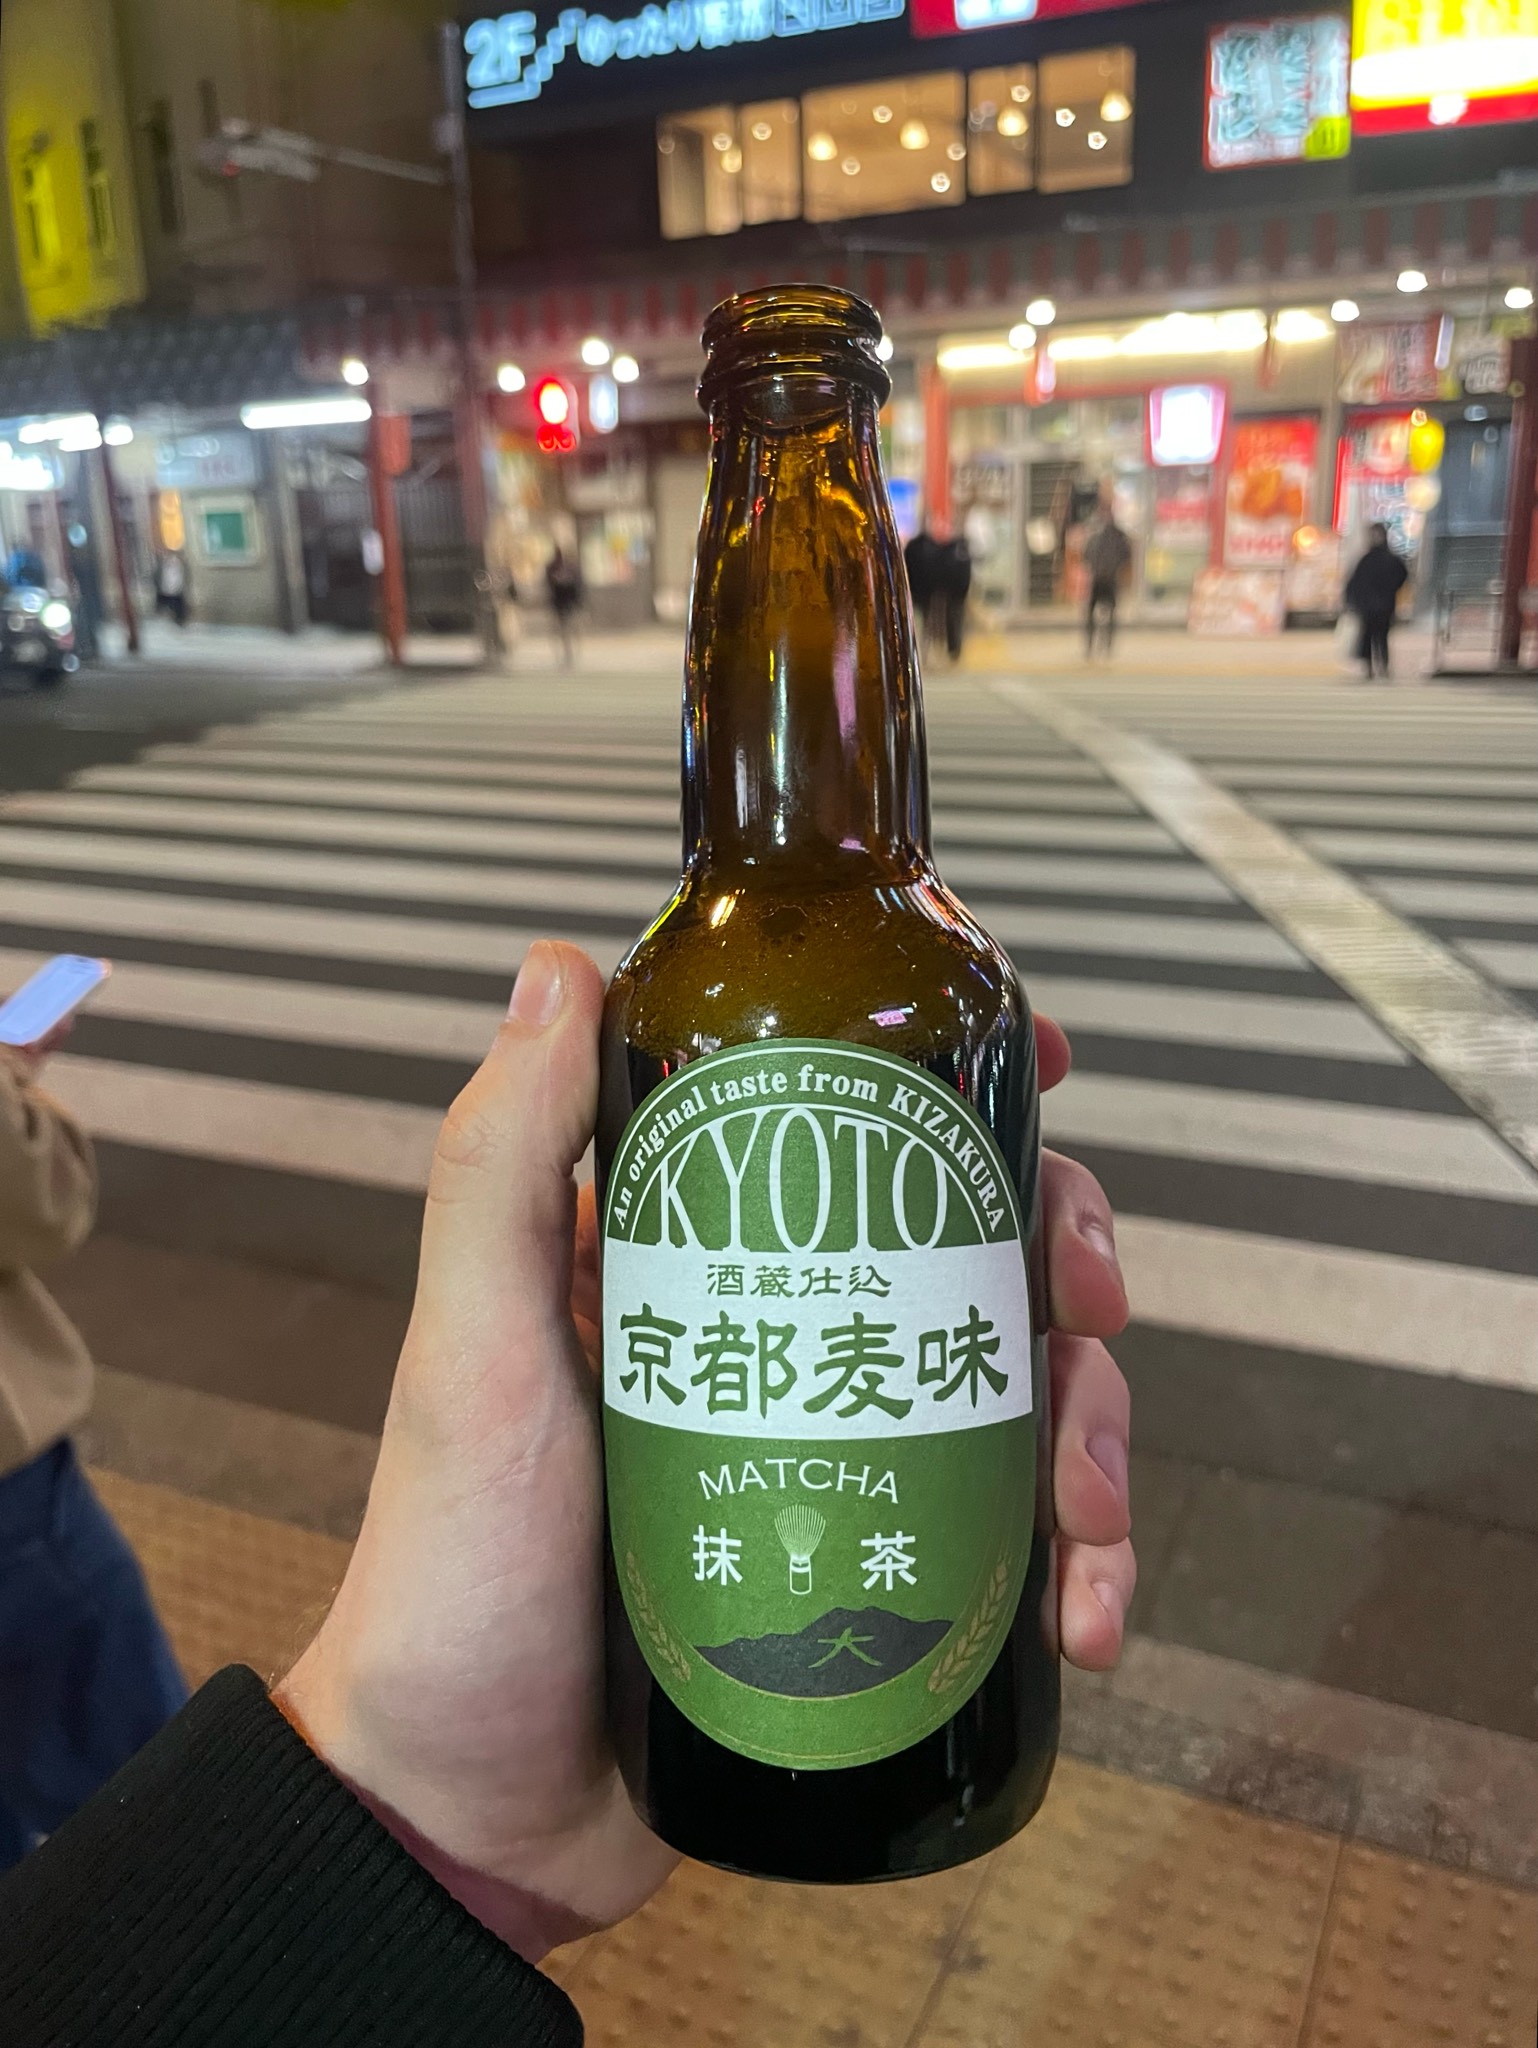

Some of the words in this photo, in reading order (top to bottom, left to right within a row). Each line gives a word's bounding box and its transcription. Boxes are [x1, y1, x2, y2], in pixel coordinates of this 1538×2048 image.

[464, 10, 537, 89] 2F
[612, 1187, 633, 1229] An
[628, 1086, 707, 1181] original
[710, 1069, 788, 1106] taste
[797, 1063, 879, 1104] from
[887, 1083, 1006, 1233] KIZAKURA
[656, 1107, 948, 1253] KYOTO
[706, 1264, 892, 1298] 酒蔵仕込
[619, 1303, 1008, 1420] 京都麦味
[698, 1458, 899, 1504] MATCHA
